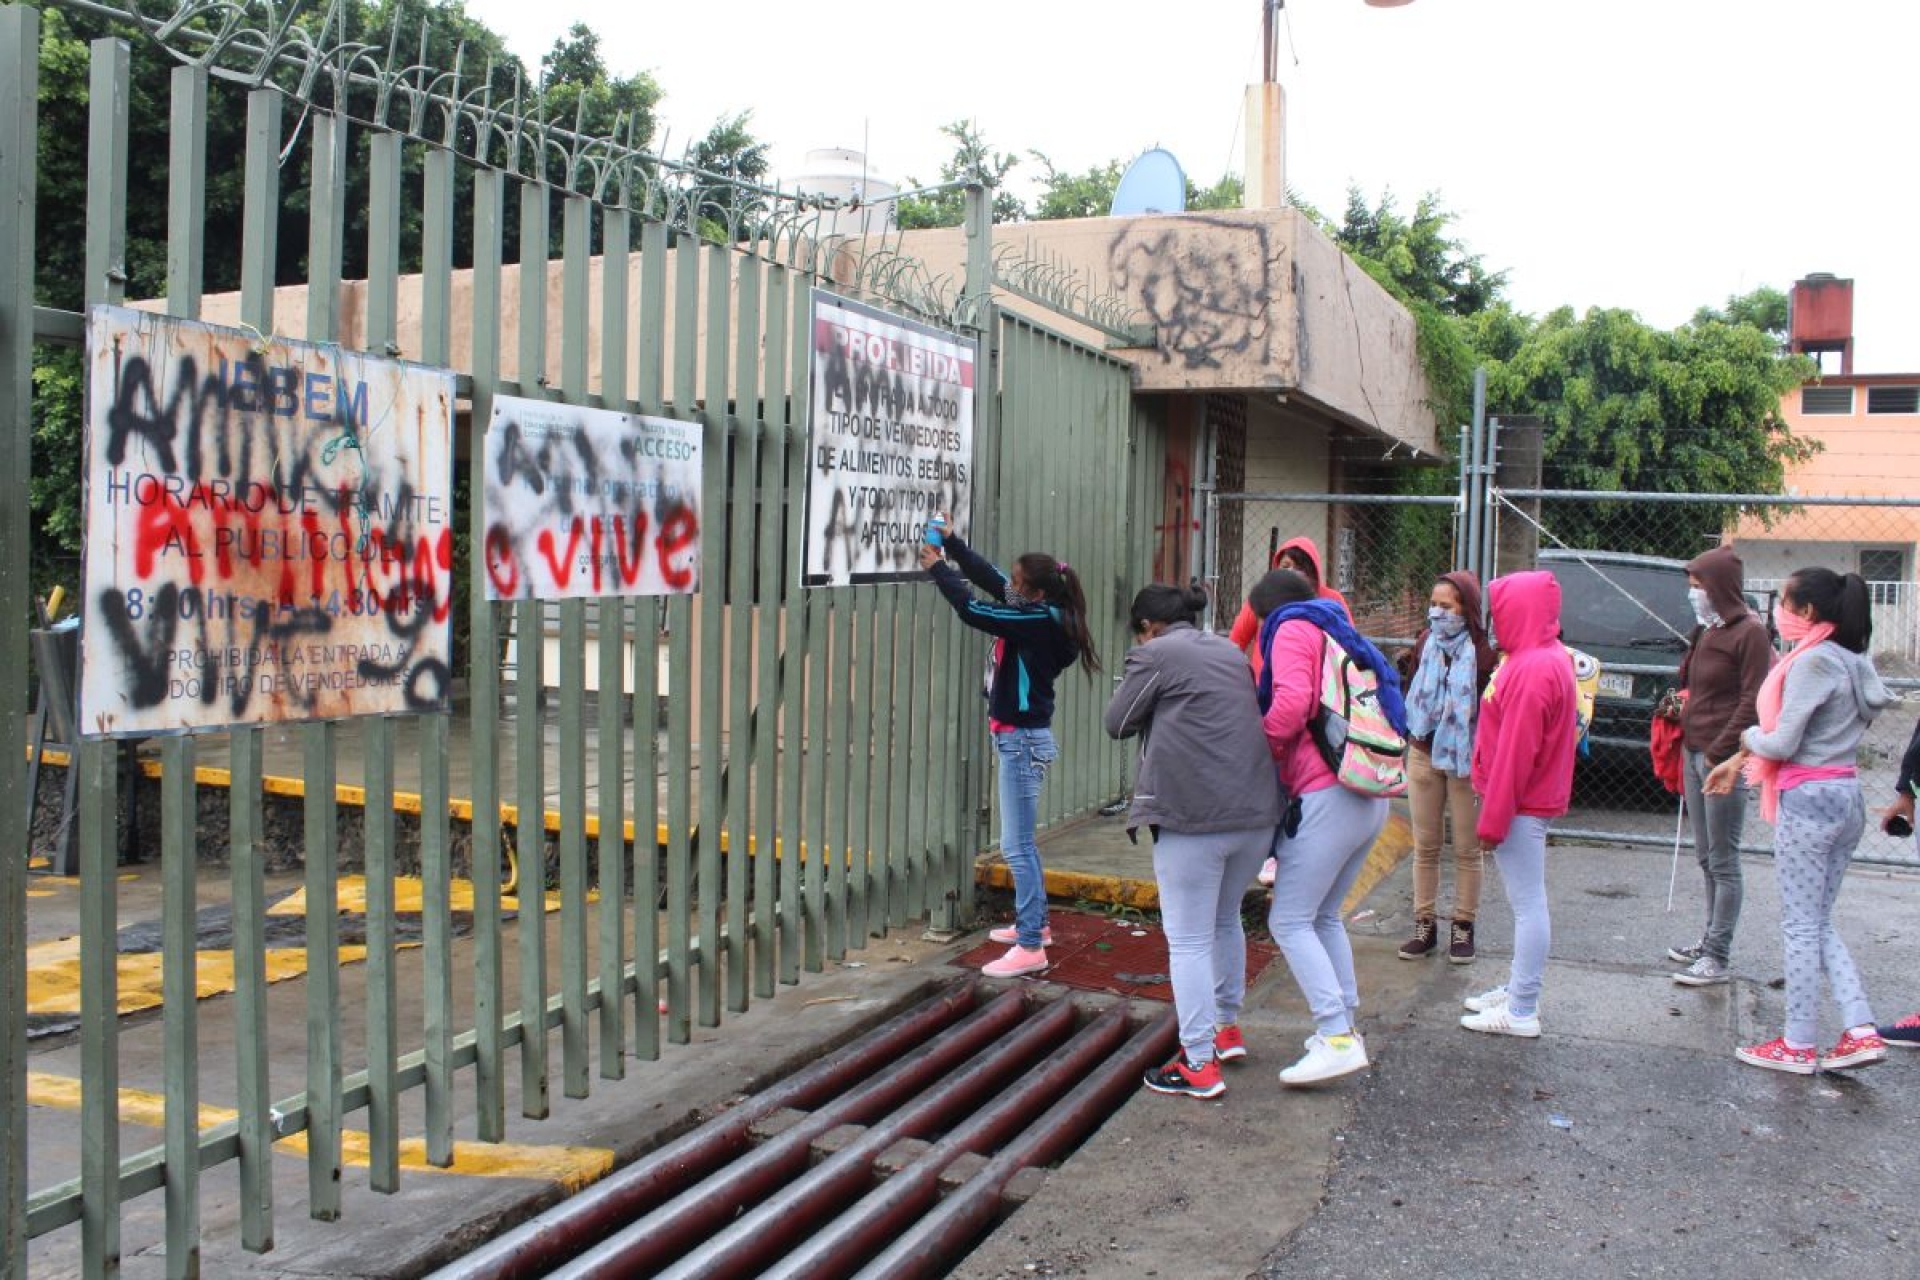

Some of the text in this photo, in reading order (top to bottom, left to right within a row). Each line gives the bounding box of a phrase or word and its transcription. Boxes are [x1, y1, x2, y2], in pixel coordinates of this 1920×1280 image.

[834, 325, 962, 386] PROHIBIDA
[831, 411, 962, 452] TIPO DE VENDEDORES
[634, 434, 691, 461] ACCESO
[817, 445, 836, 470] DE
[106, 469, 266, 514] HORARIO
[277, 484, 318, 517] DE
[849, 486, 858, 508] Y
[861, 486, 895, 510] TODO
[899, 489, 926, 513] TIPO
[162, 525, 203, 558] AL
[215, 527, 350, 563] PUBLICO
[167, 646, 276, 671] PROHIBIDA
[311, 643, 393, 665] ENTRADA
[260, 673, 288, 694] DE
